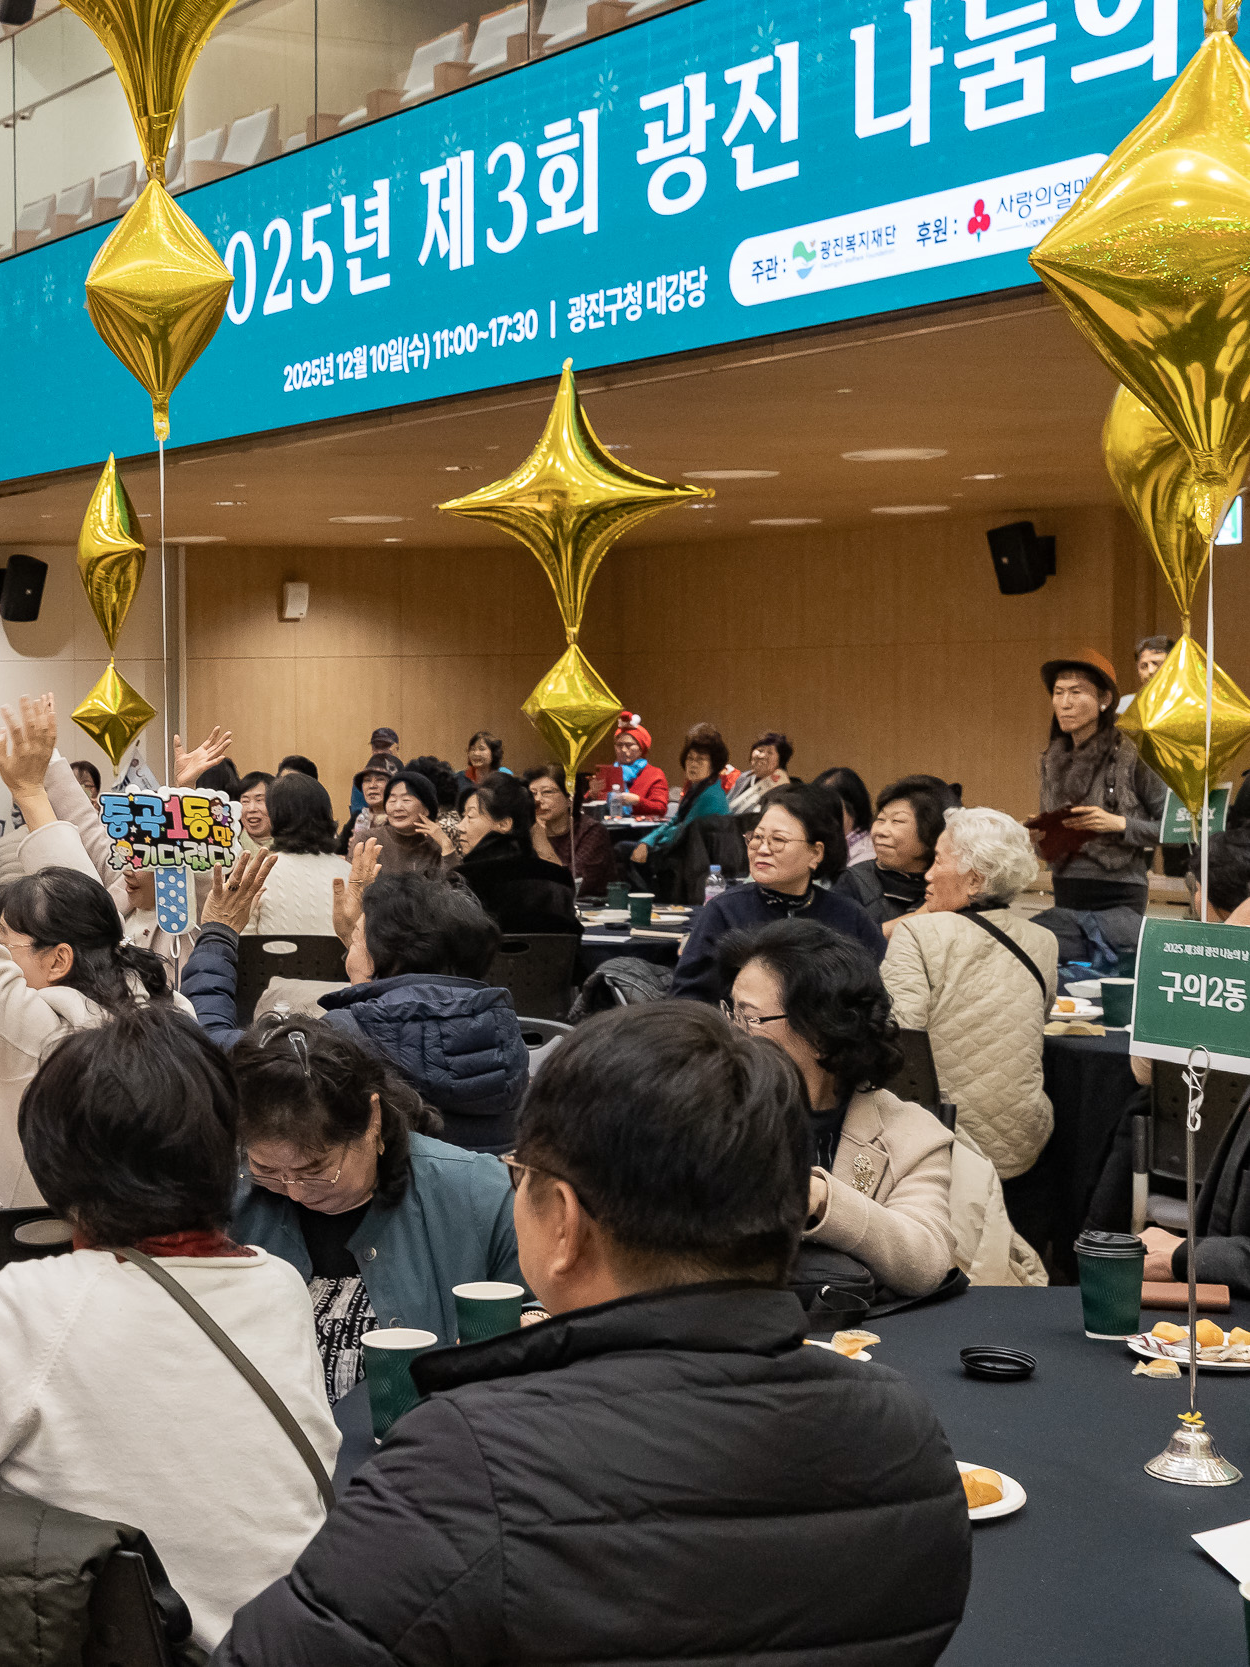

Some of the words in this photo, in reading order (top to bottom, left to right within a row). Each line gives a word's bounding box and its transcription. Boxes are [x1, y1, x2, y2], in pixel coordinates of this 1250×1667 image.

[224, 178, 391, 326] 025년
[417, 109, 599, 271] 제3회
[636, 43, 799, 216] 광진
[751, 256, 779, 284] 주관
[820, 224, 897, 261] 광진복지재단
[916, 216, 948, 247] 후원
[283, 351, 335, 393] 2025년
[336, 344, 369, 384] 12월
[370, 332, 431, 375] 10일(수)
[433, 308, 539, 360] 11:00~17:30
[567, 280, 644, 334] 광진구청
[646, 265, 709, 323] 대강당
[132, 841, 234, 870] 기다렸다
[1158, 971, 1248, 1012] 구의2동
